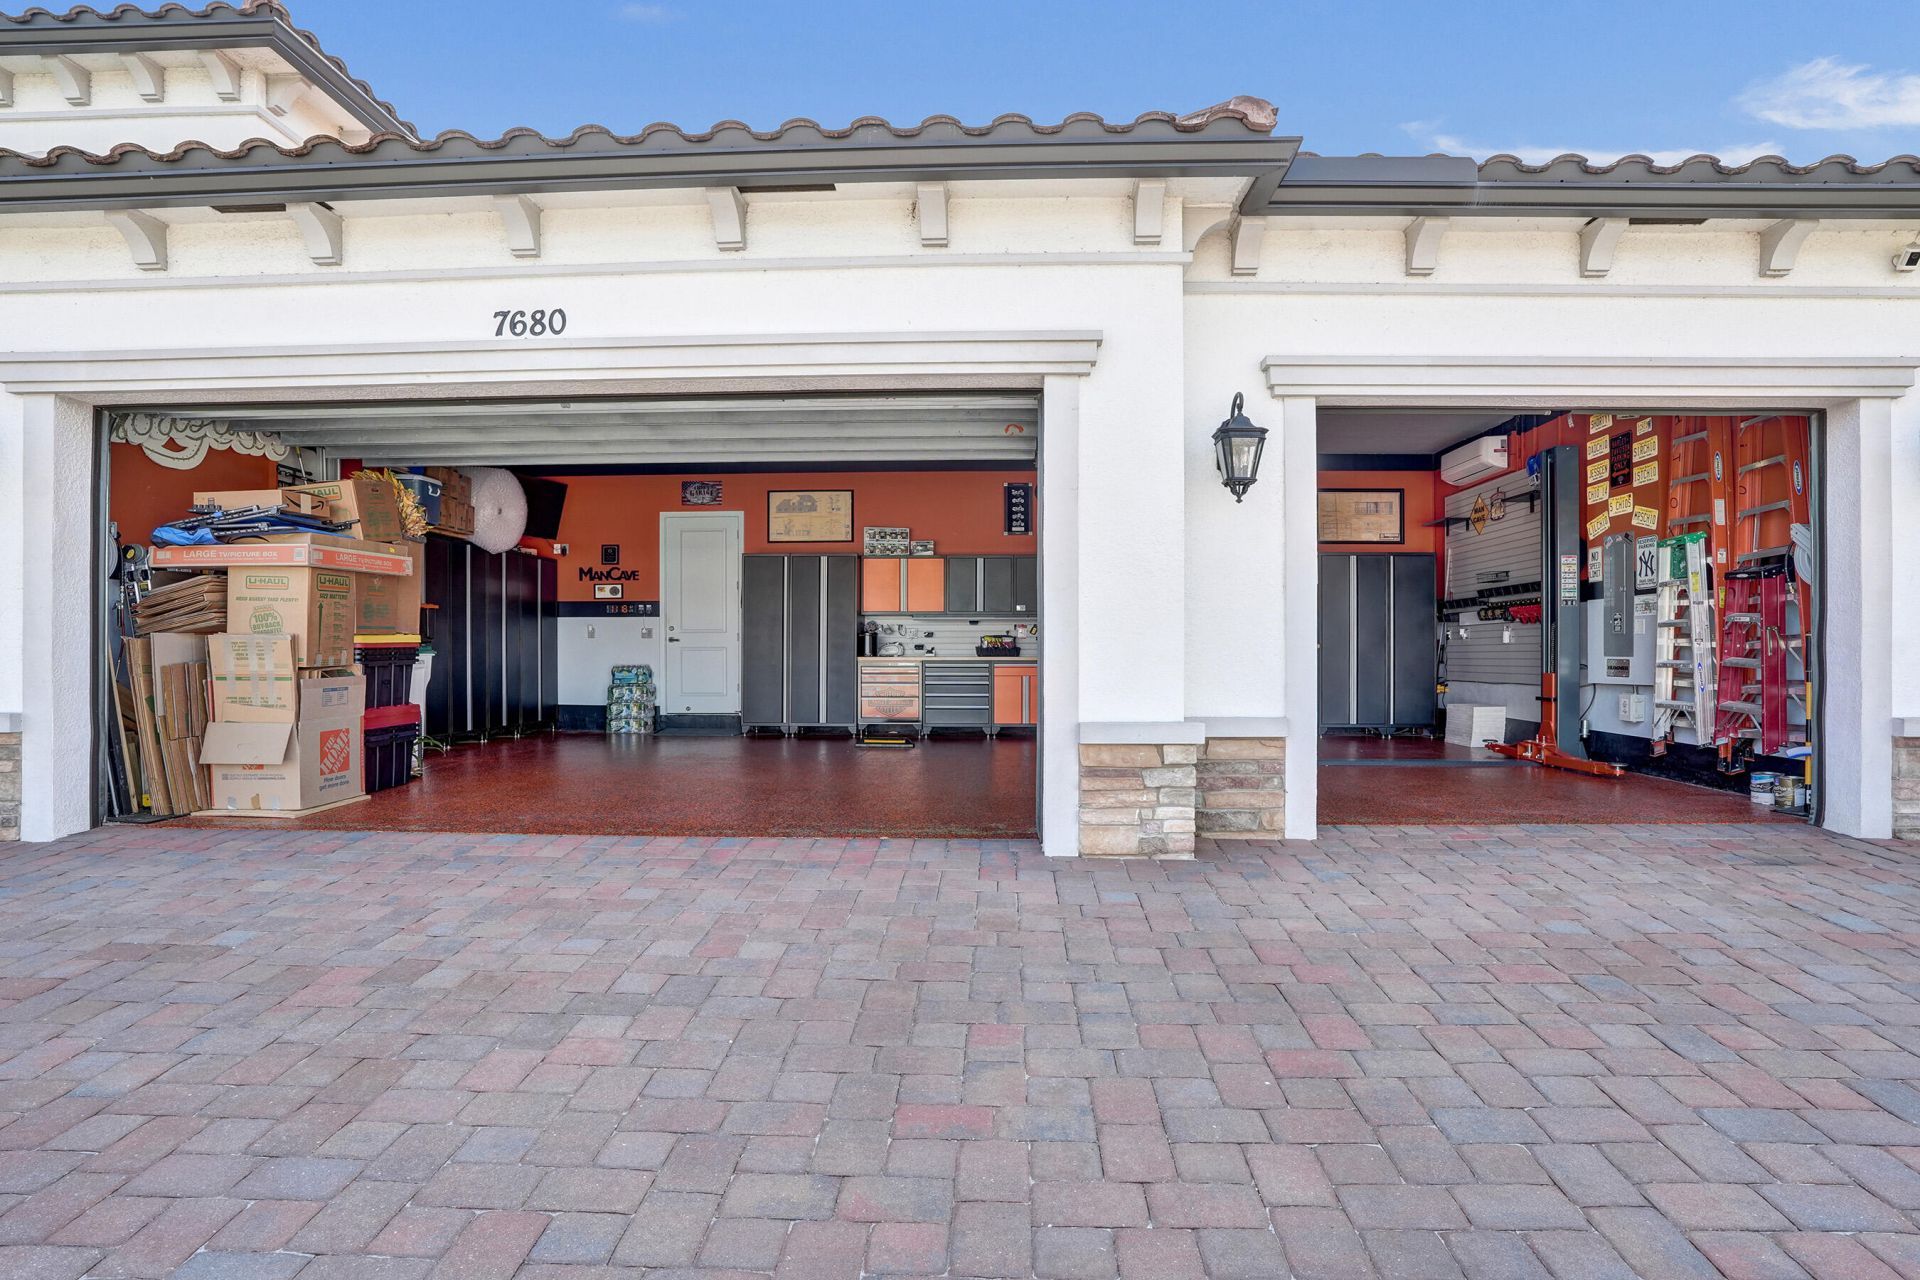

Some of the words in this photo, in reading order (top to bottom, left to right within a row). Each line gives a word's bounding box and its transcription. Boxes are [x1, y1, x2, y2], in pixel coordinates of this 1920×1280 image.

[493, 308, 567, 336] 7680
[1612, 453, 1629, 463] PARKING
[1614, 461, 1627, 470] ONLY
[183, 549, 217, 558] LARGE
[335, 552, 357, 562] LARGE
[1591, 551, 1599, 561] NO
[1589, 562, 1601, 570] SPEED
[1589, 570, 1601, 578] LIMIT
[319, 576, 349, 587] U-HAUL
[253, 612, 278, 623] 100%
[320, 728, 350, 775] HOME
[331, 745, 350, 773] DEPOT
